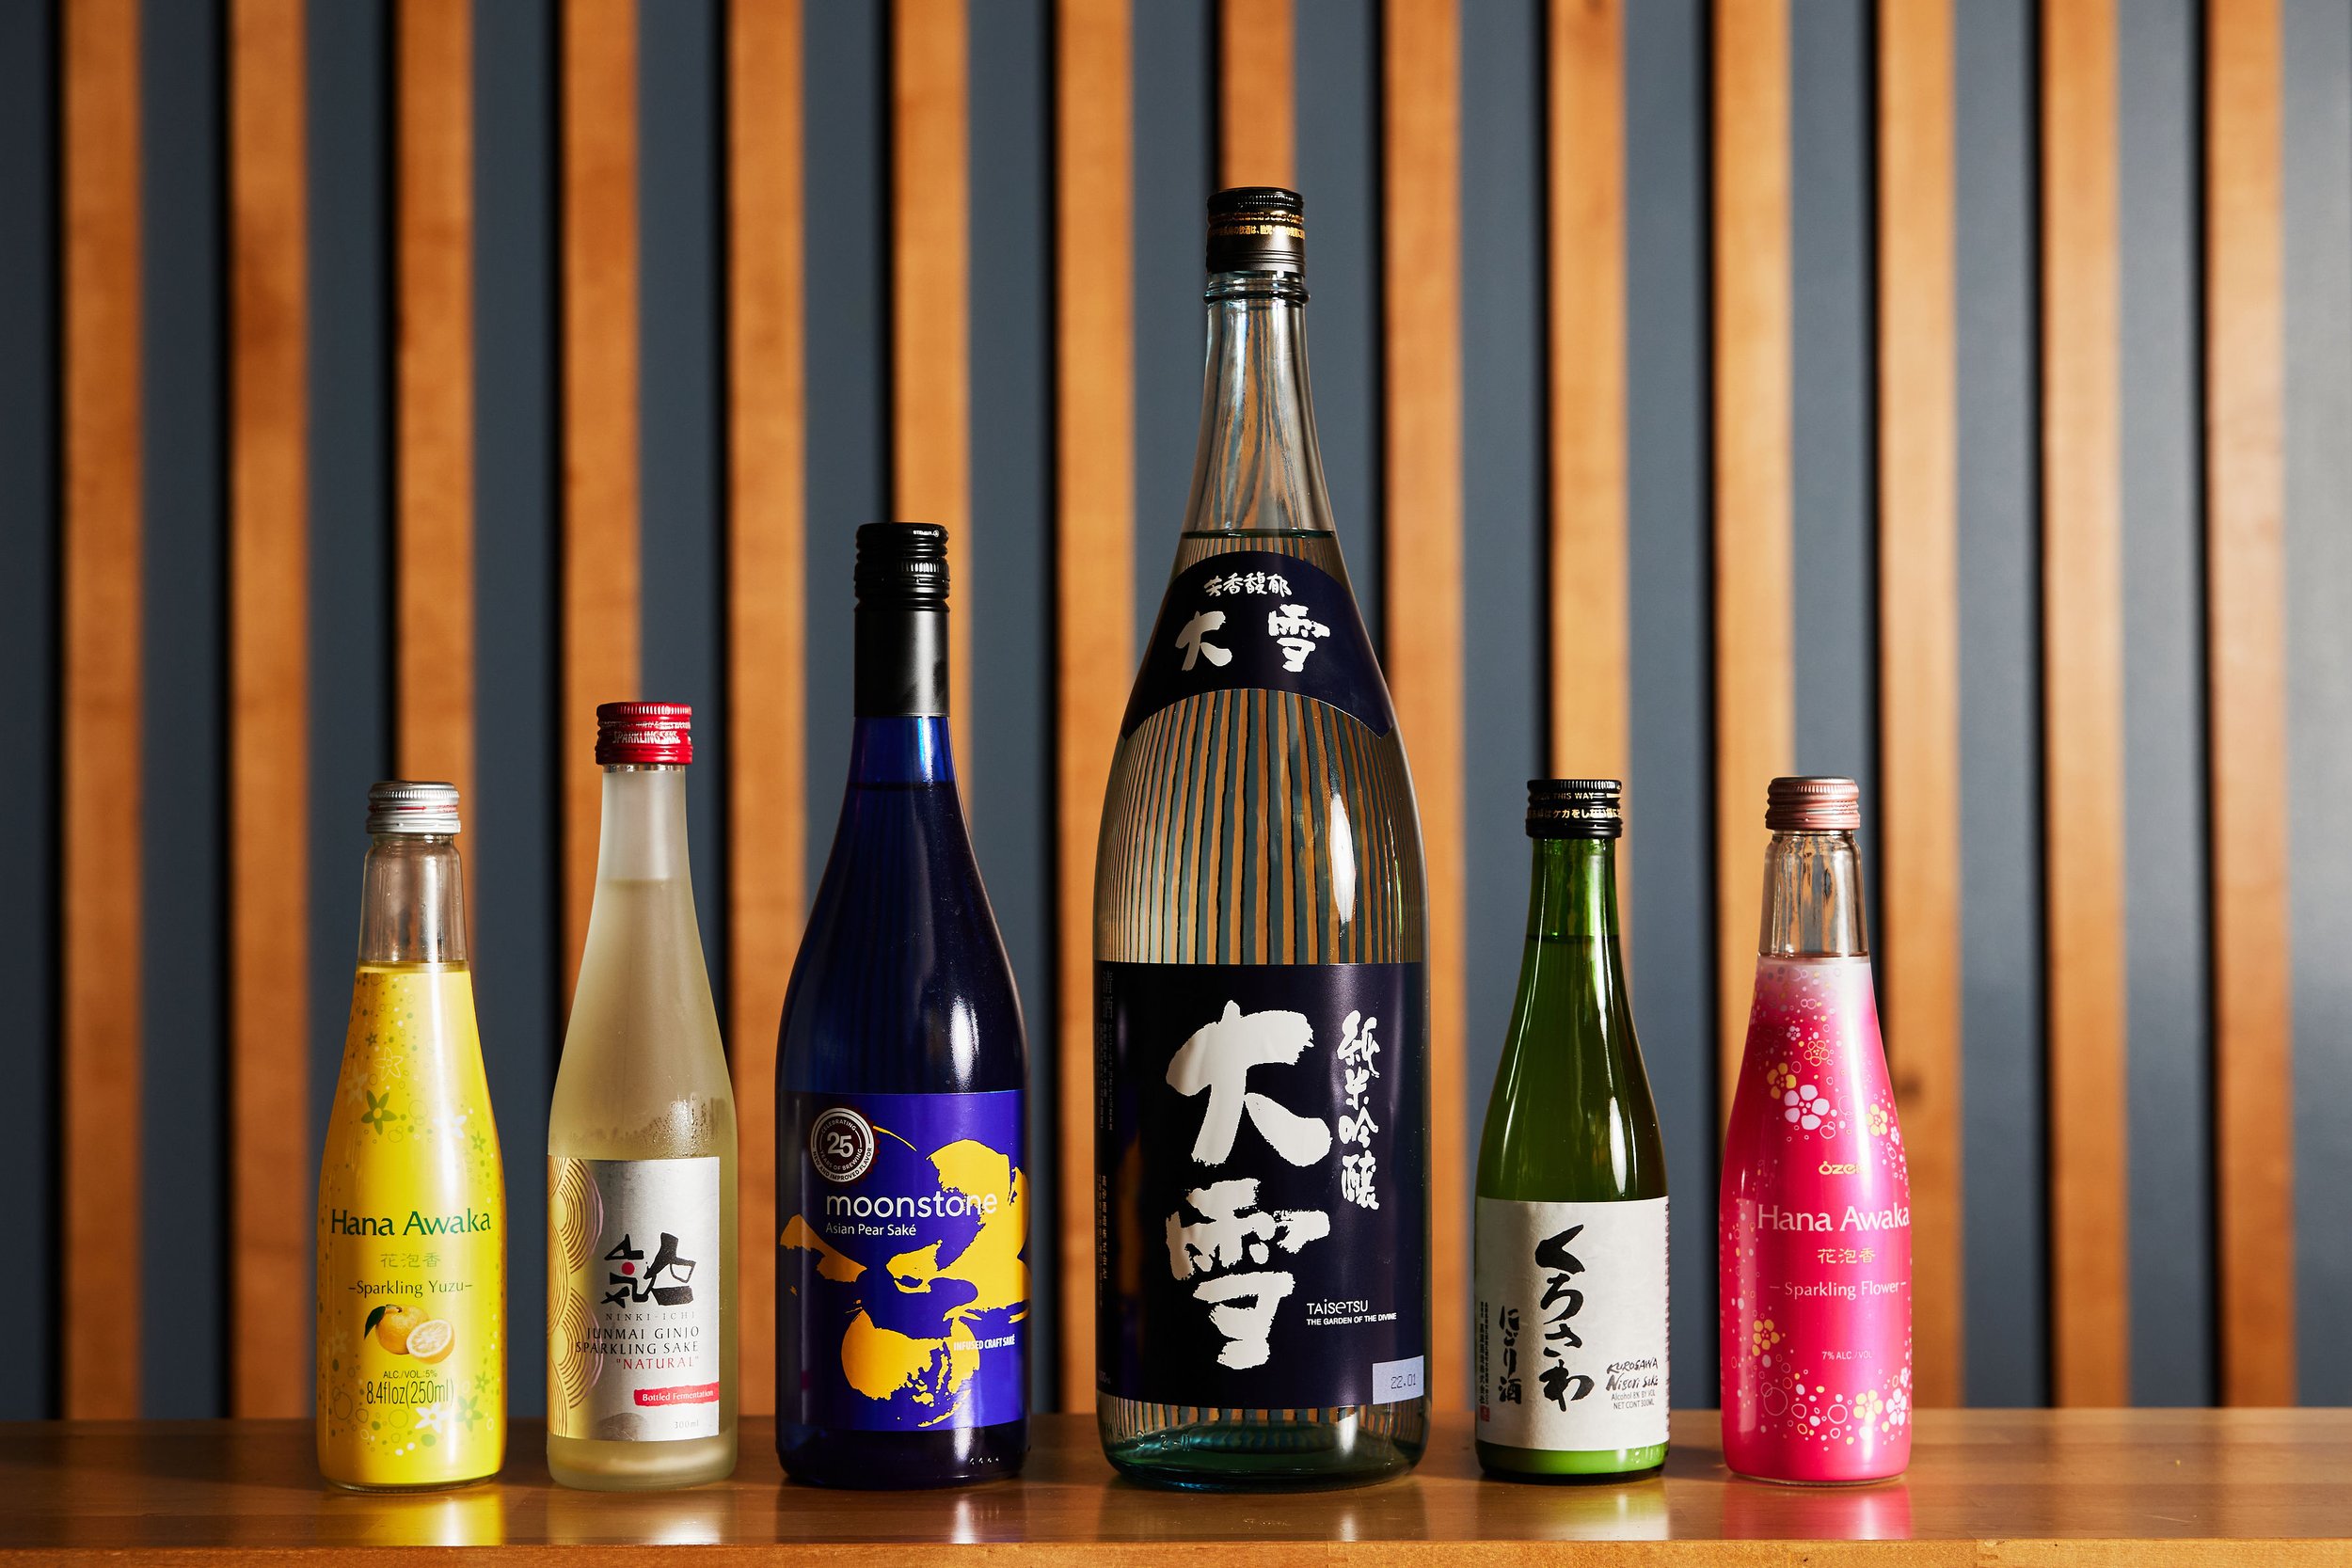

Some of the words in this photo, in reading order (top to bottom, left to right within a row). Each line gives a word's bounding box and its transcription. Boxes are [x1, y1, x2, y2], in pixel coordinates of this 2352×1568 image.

[821, 1118, 857, 1133] CELEBRATING
[827, 1132, 854, 1158] 25
[818, 1165, 830, 1177] AND
[830, 1169, 860, 1181] IMPROVED
[859, 1147, 872, 1171] FLAVOR
[820, 1150, 833, 1168] YEARS
[842, 1148, 863, 1171] BREWING
[826, 1191, 998, 1218] moonstone
[331, 1209, 395, 1236] Hana
[403, 1208, 491, 1236] Awaka
[1757, 1203, 1834, 1232] Hana
[1839, 1202, 1910, 1232] Awaka
[825, 1222, 855, 1235] Asian
[858, 1224, 885, 1236] Pear
[887, 1224, 916, 1236] Saké
[380, 1252, 441, 1268] 花泡香
[1818, 1248, 1877, 1264] 花泡香
[1786, 1282, 1856, 1300] Sparkling
[606, 1311, 695, 1322] NINKI-ICHI
[1323, 1317, 1352, 1325] GARDEN
[1378, 1313, 1396, 1322] DIVINE
[1534, 1224, 1596, 1412] くろさわ
[587, 1327, 644, 1339] JUNMAI
[655, 1326, 699, 1339] GINJO
[576, 1341, 657, 1354] SPARKLING
[663, 1341, 698, 1354] SAKE
[953, 1339, 983, 1351] INFUSED
[984, 1338, 1003, 1349] CRAFT
[616, 1356, 699, 1370] "NATURAL"
[1499, 1306, 1521, 1404] にごり酒
[1821, 1351, 1835, 1360] 7%
[1607, 1357, 1658, 1374] KUROSAWA
[1391, 1373, 1417, 1389] 22.01
[1606, 1372, 1640, 1391] Nigori
[643, 1390, 671, 1402] Bottled
[673, 1389, 714, 1402] Fermentation
[1611, 1392, 1632, 1402] Alcohol
[1613, 1402, 1625, 1410] NET
[1625, 1400, 1640, 1409] CONT
[675, 1419, 699, 1429] 300ml
